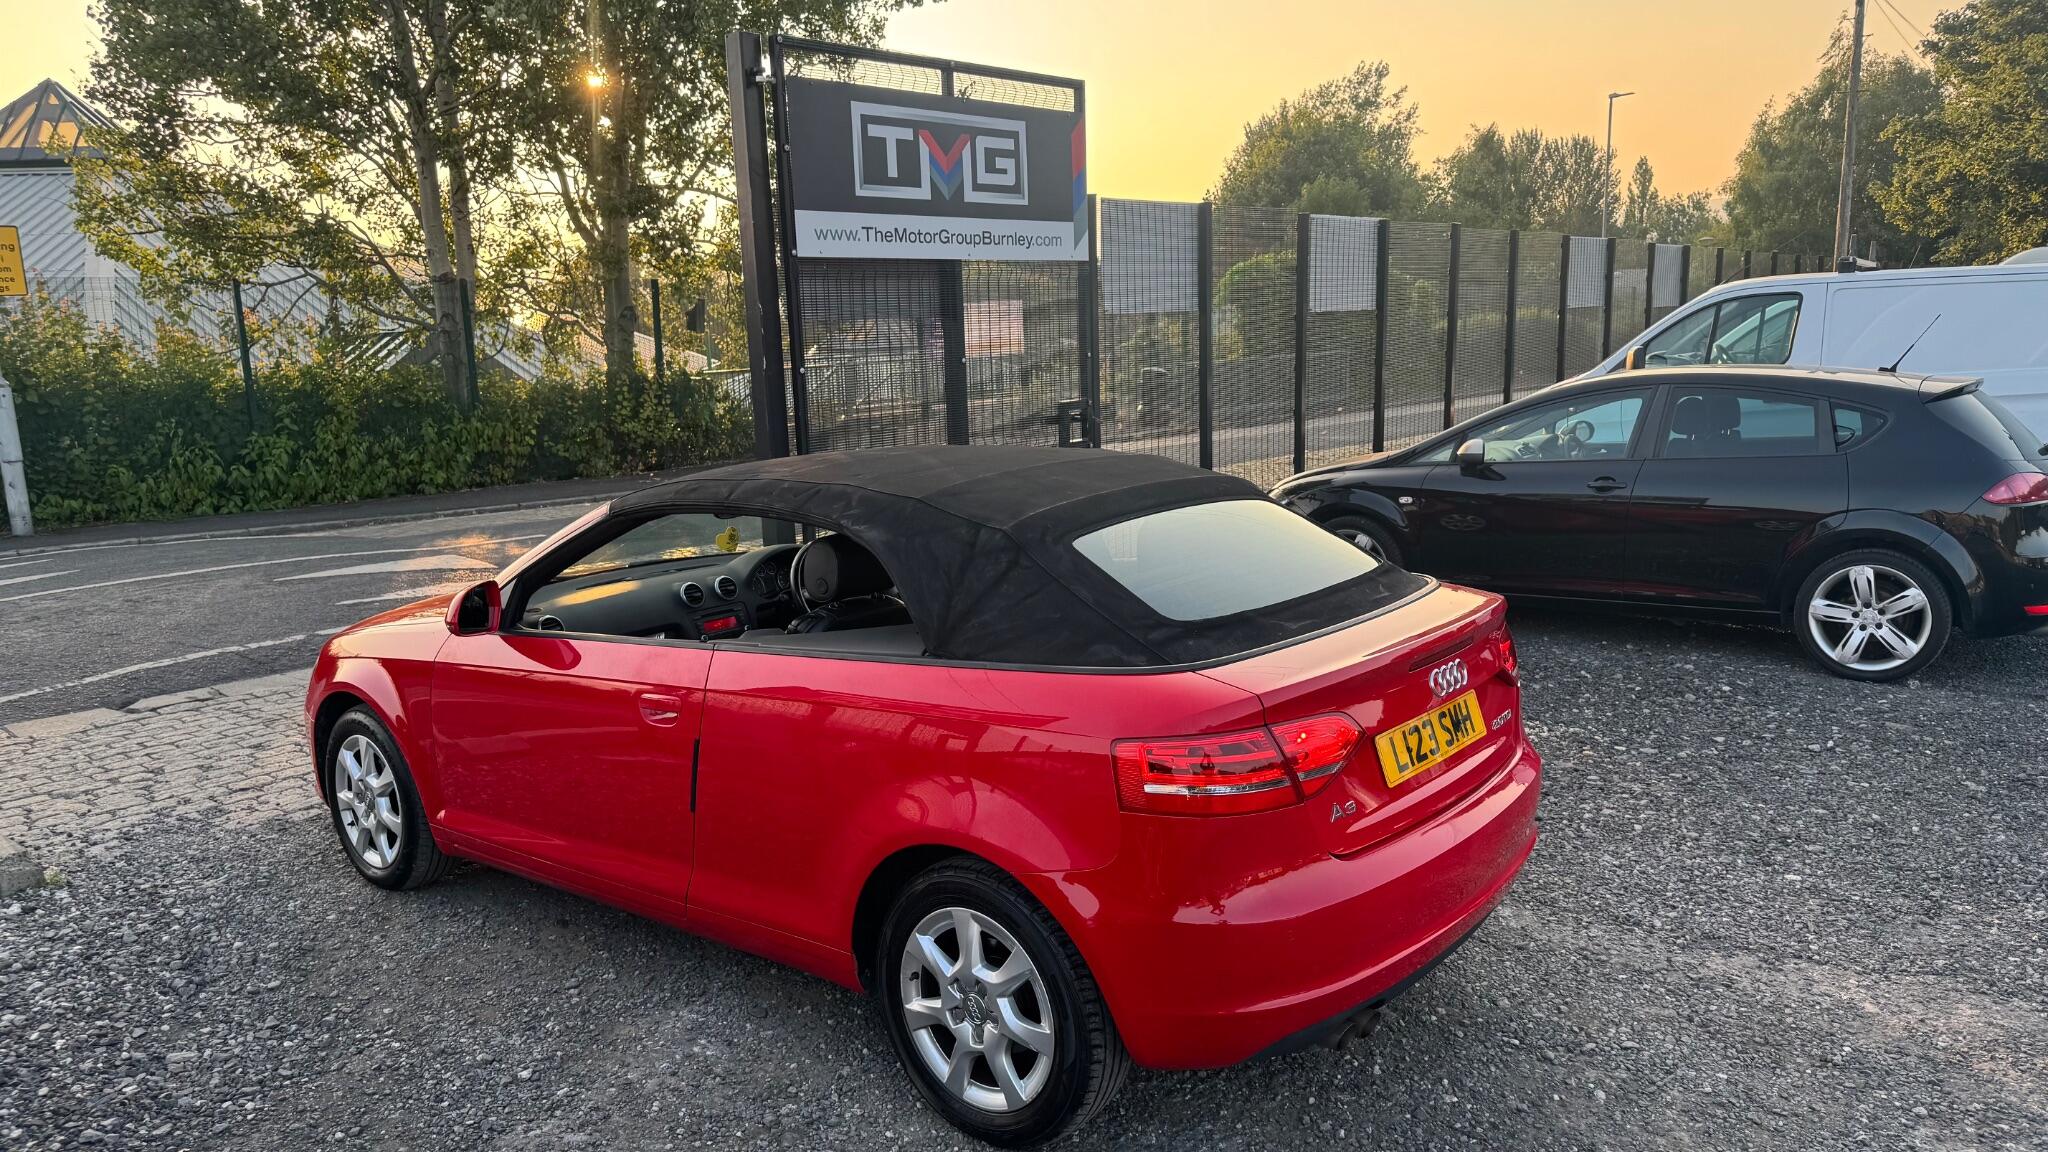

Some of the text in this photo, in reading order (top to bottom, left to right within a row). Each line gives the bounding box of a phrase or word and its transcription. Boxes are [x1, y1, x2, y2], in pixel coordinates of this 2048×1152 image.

[867, 123, 1016, 200] TMG
[814, 226, 1062, 248] www.TheMotorGroupBurnley.com
[1438, 699, 1476, 748] SMH
[1331, 800, 1356, 822] A3
